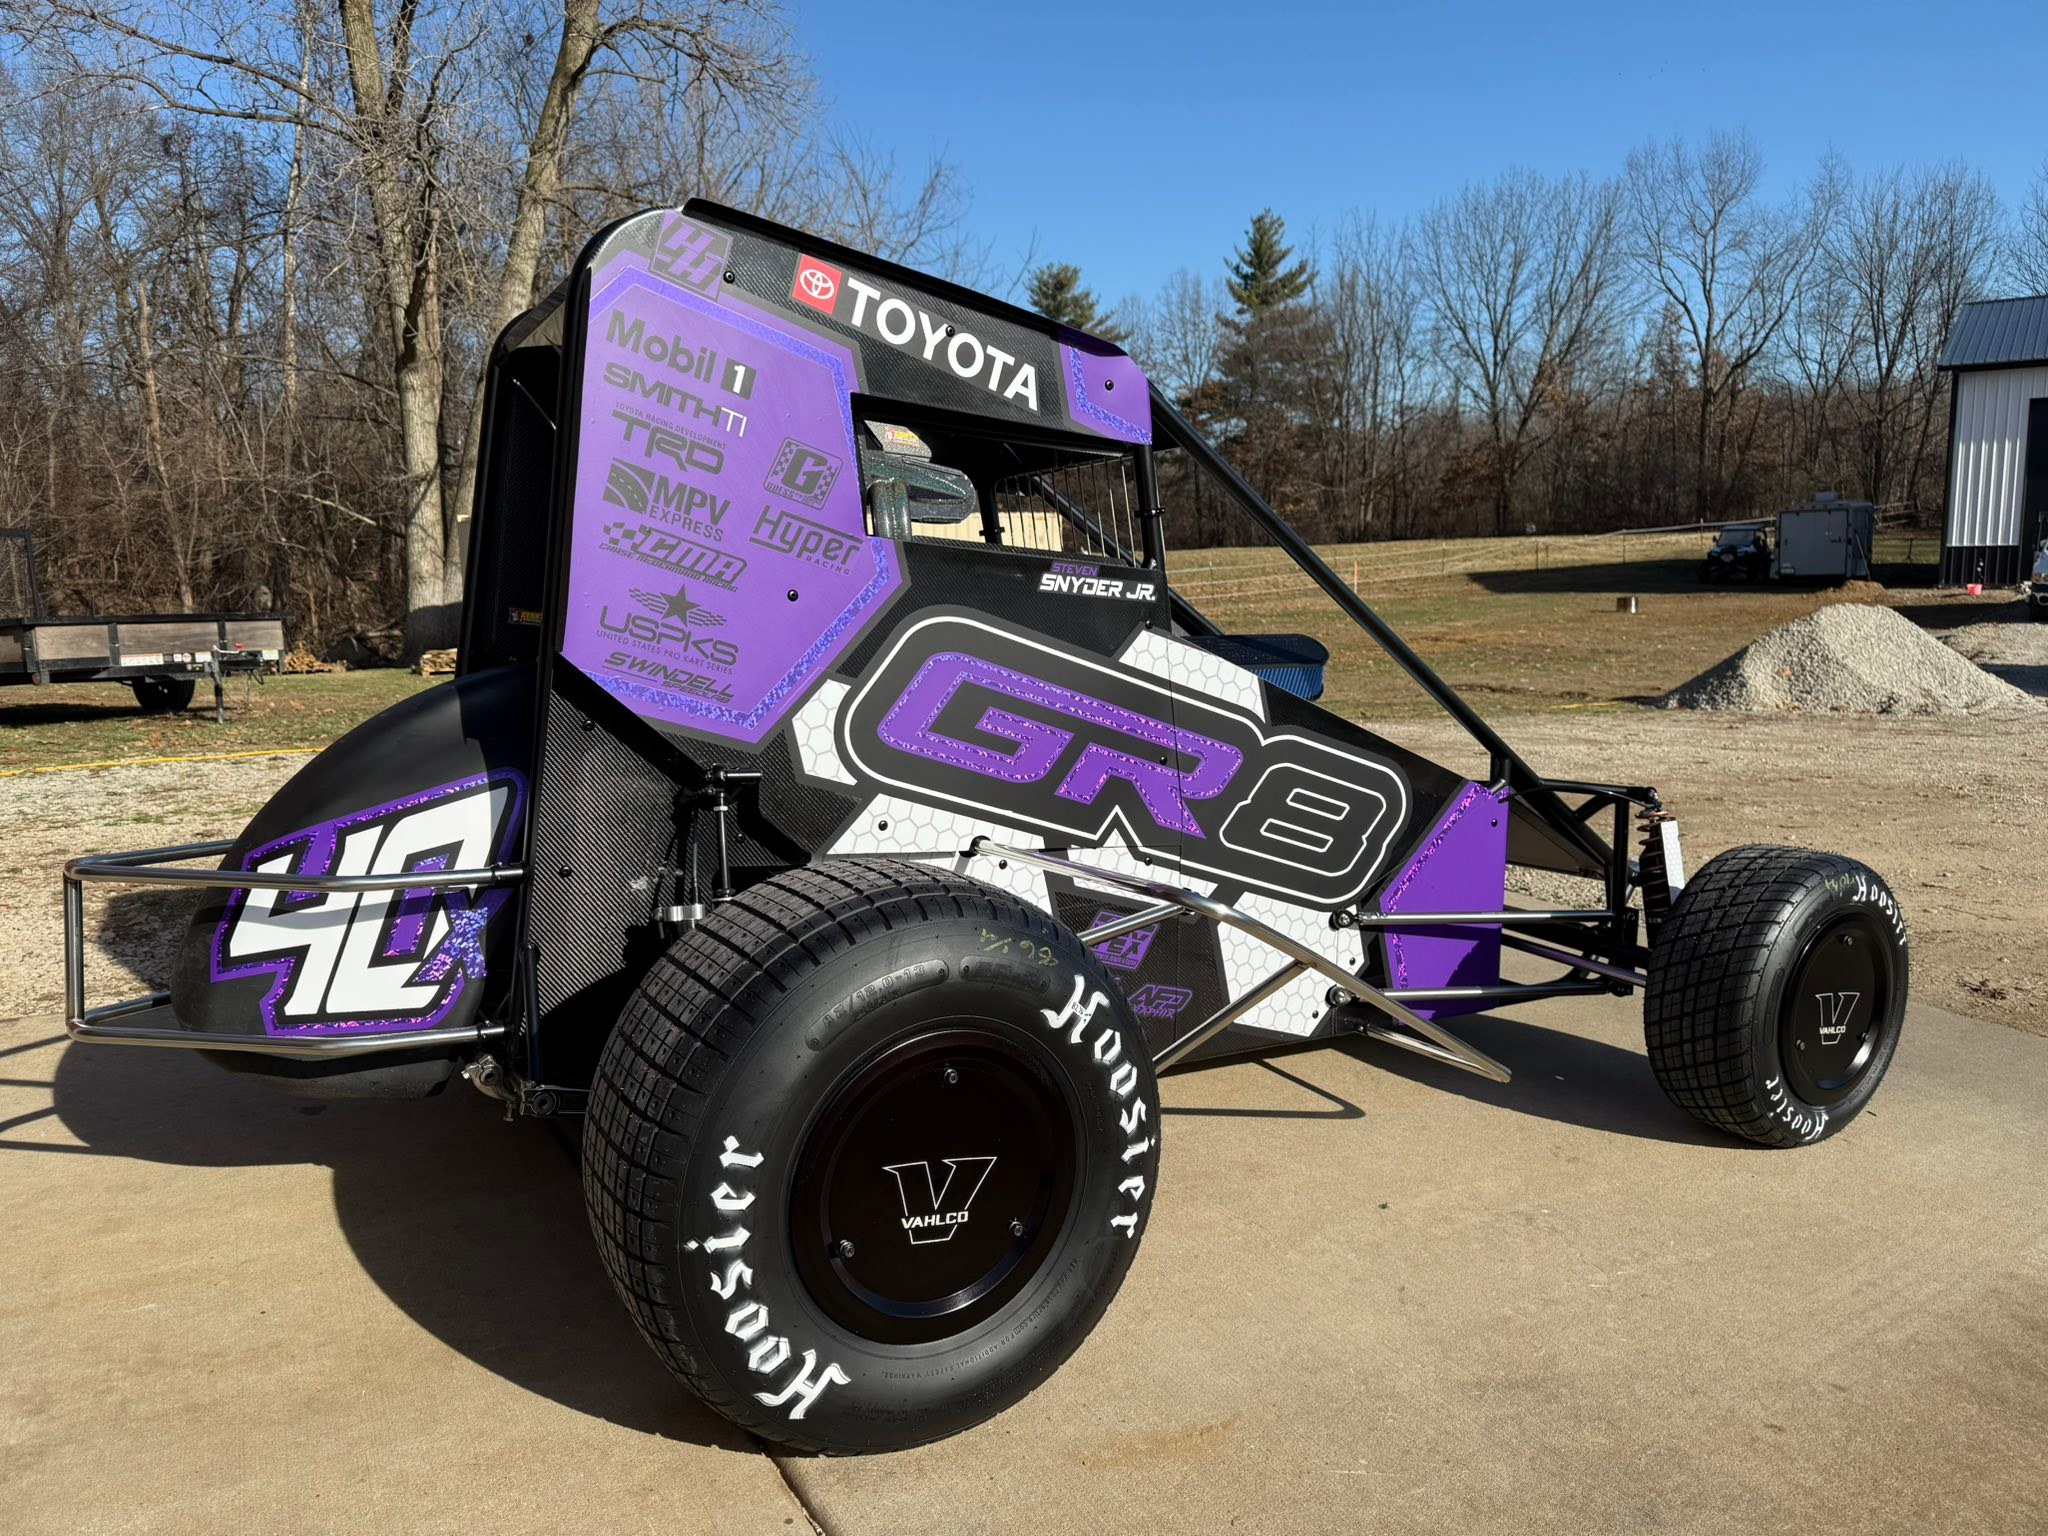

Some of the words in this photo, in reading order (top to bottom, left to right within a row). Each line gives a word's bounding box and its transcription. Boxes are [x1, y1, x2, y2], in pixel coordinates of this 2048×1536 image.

[606, 309, 717, 383] Mobil
[733, 364, 747, 394] 1
[848, 277, 1038, 411] TOYOTA
[612, 410, 724, 475] TRD
[615, 402, 643, 418] TOYOTA
[645, 413, 673, 430] RACING
[675, 425, 726, 450] DEVELOPMENT
[649, 505, 723, 542] EXPRESS
[652, 475, 731, 527] MPV
[749, 504, 863, 566] Hyper
[805, 555, 850, 575] RACING
[1039, 573, 1124, 598] SNYDER
[1126, 583, 1156, 601] JR.
[1052, 562, 1098, 577] STEVEN
[596, 630, 629, 645] UNITED
[631, 640, 662, 655] STATES
[664, 649, 681, 660] PRO
[683, 655, 704, 667] KART
[706, 661, 733, 676] SERIES
[600, 605, 739, 666] USPKS
[604, 651, 735, 698] SWINDELL
[661, 680, 731, 704] SPEEDLAB
[877, 651, 1387, 877] GR8
[1852, 874, 1907, 946] Hoosier
[1819, 1025, 1846, 1035] VAHLCO
[1040, 974, 1157, 1239] Hoosier
[1765, 1074, 1829, 1141] Hoosier
[901, 1211, 969, 1230] VAHLCO
[685, 1135, 852, 1420] Hoosier
